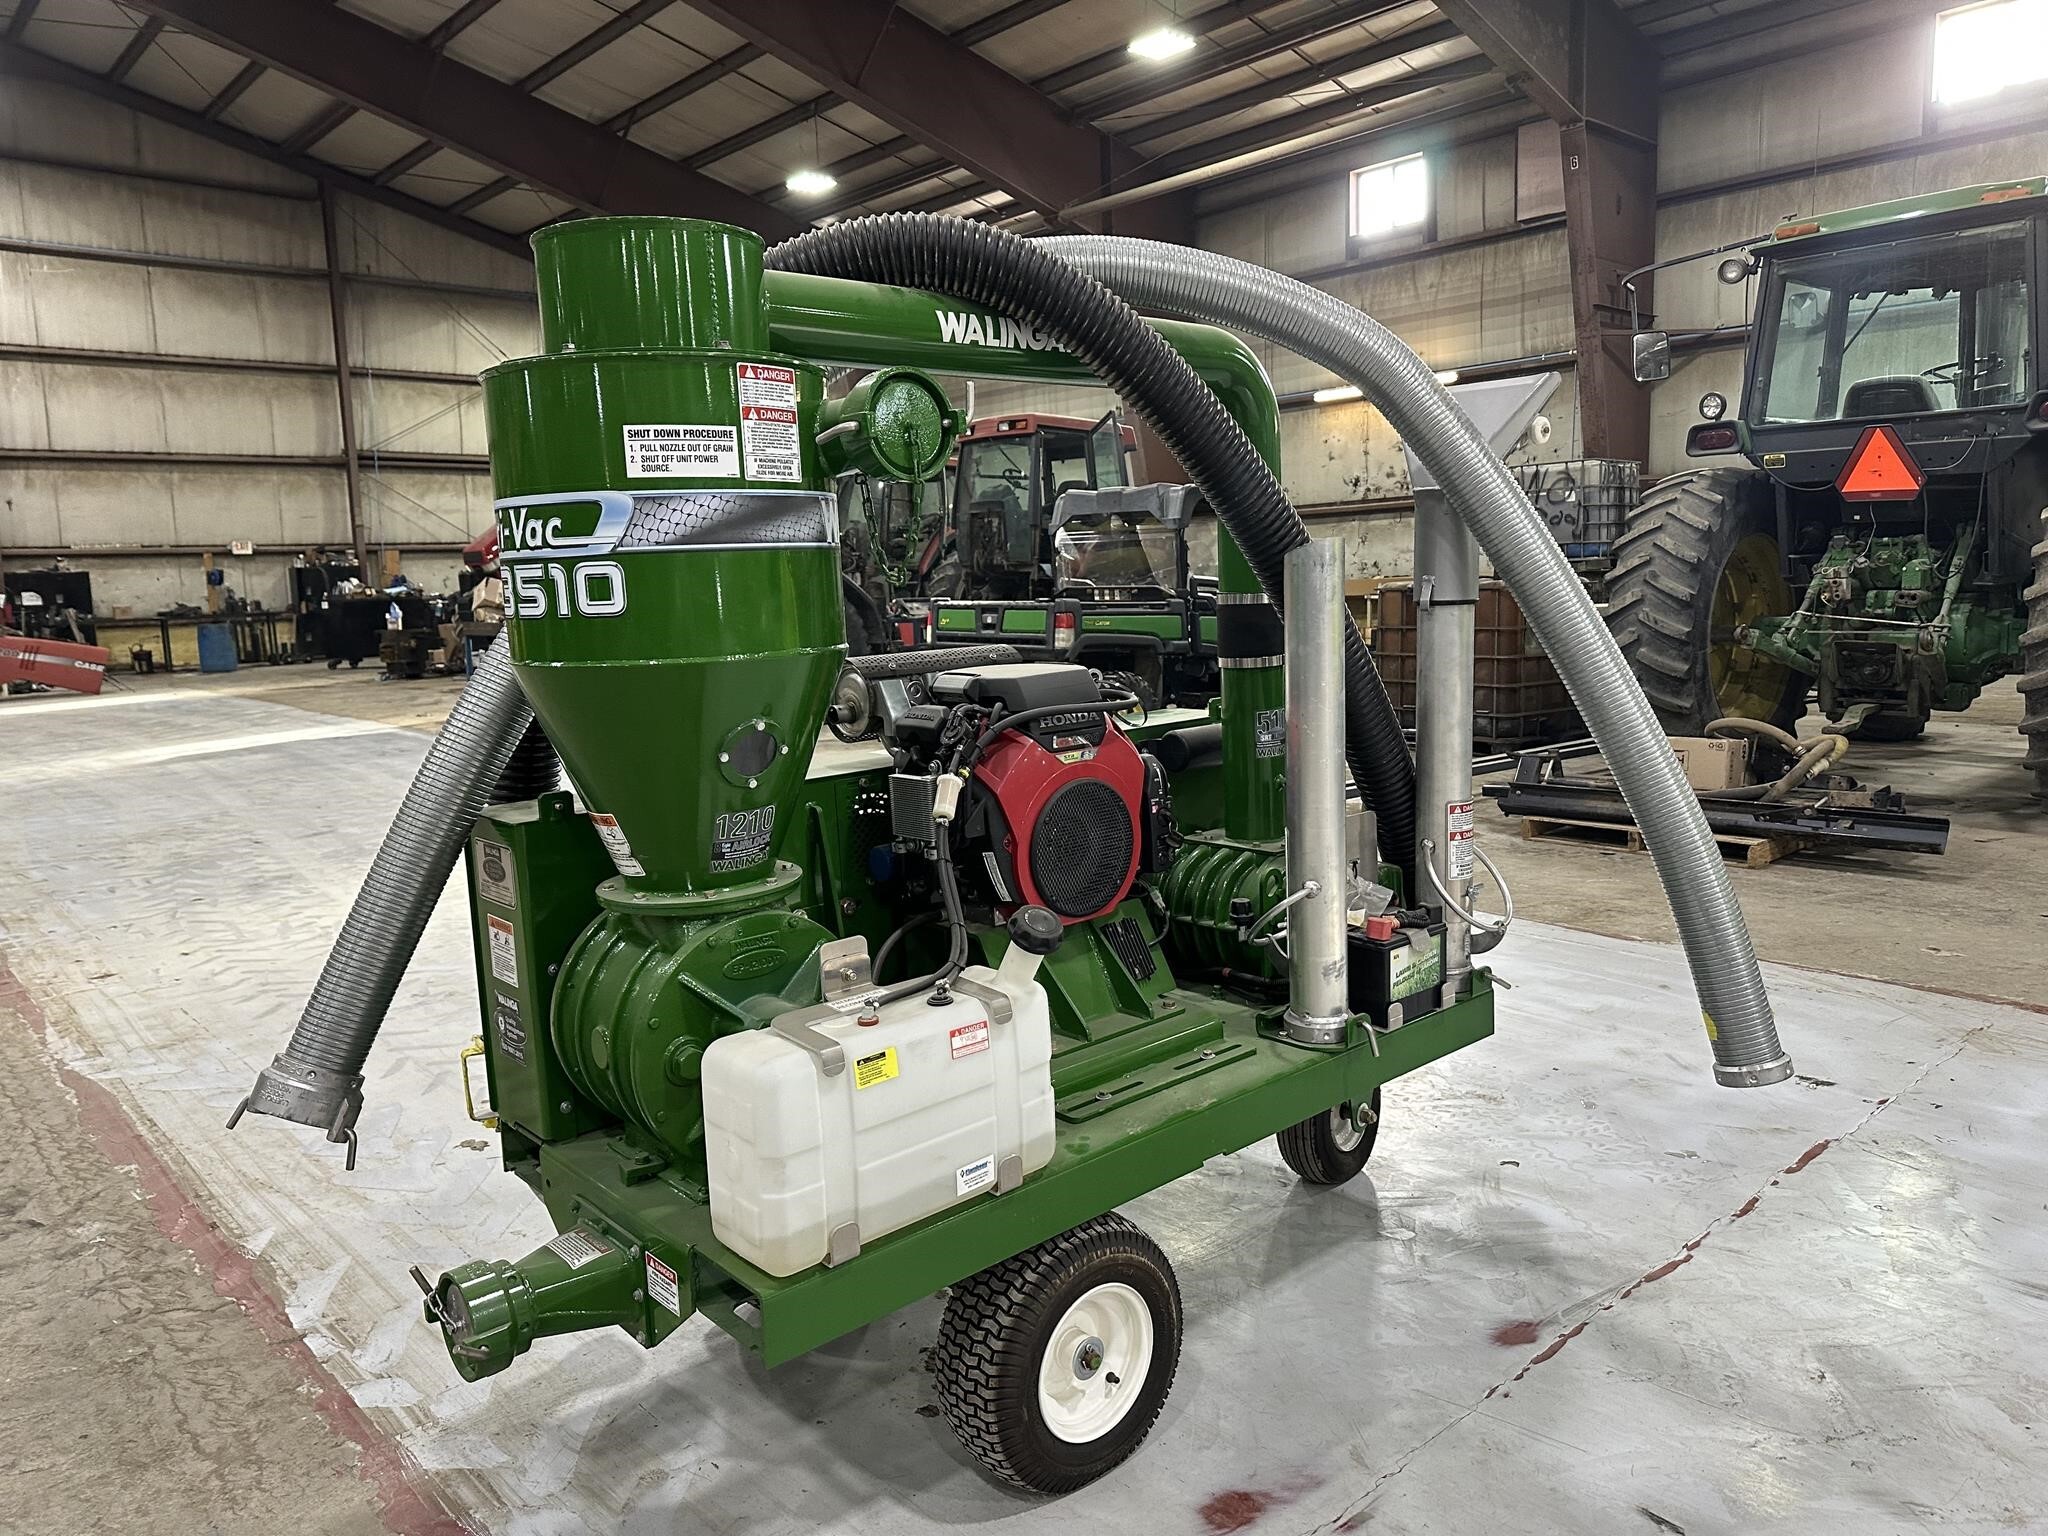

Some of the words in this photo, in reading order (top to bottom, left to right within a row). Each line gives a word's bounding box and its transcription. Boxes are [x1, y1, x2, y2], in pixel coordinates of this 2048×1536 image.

[757, 368, 790, 381] DANGER
[760, 410, 793, 421] DANGER
[627, 429, 651, 438] SHUT
[653, 429, 680, 438] DOWN
[683, 429, 734, 439] PROCEDURE
[630, 444, 637, 452] 1.
[640, 444, 658, 452] PULL
[660, 444, 686, 452] NOZZLE
[688, 444, 701, 452] OUT
[703, 444, 711, 452] OF
[713, 444, 733, 452] GRAIN
[630, 455, 637, 463] 2.
[641, 455, 659, 463] SHUT
[661, 455, 674, 463] OFF
[676, 455, 692, 463] UNIT
[694, 455, 719, 463] POWER
[641, 464, 672, 472] SOURCE.
[1039, 712, 1100, 728] HONDA
[716, 805, 776, 839] 1210
[731, 832, 771, 851] AIRLOCK
[711, 850, 769, 873] WALINGA
[961, 1023, 985, 1035] DANGER
[655, 1261, 674, 1280] DANGER
